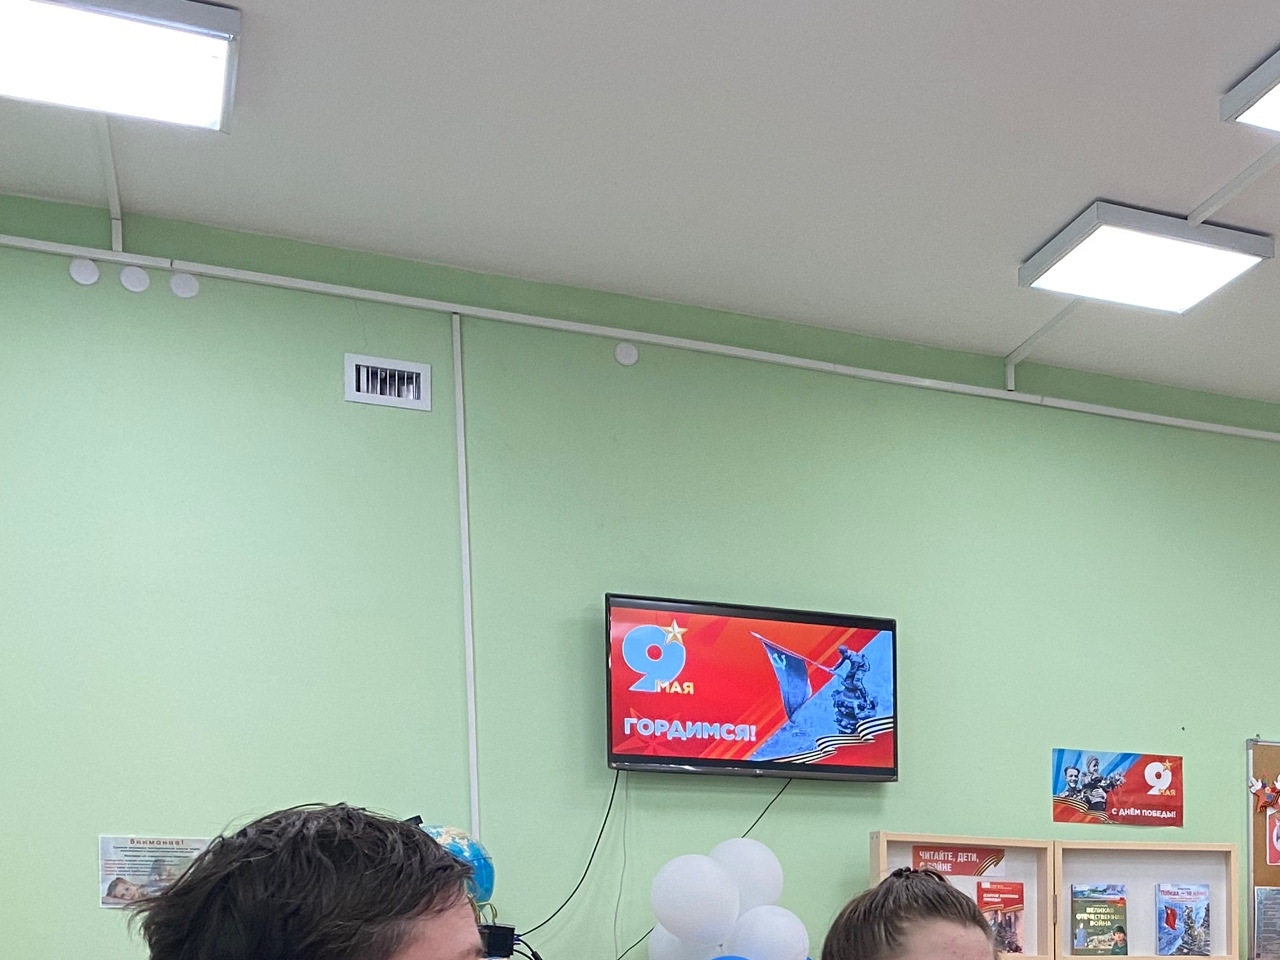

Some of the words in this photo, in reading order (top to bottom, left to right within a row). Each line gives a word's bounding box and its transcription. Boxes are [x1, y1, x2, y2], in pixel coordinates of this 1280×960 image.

[622, 624, 686, 693] 9
[656, 679, 694, 695] МАЯ
[624, 717, 757, 742] ГОРДИМСЯ!
[1144, 761, 1173, 795] 9
[1158, 788, 1176, 796] МАЯ
[1119, 807, 1141, 817] ДНЁМ
[1141, 809, 1177, 819] ПОБЕДЫ!
[130, 838, 184, 846] Внимание!
[919, 850, 956, 861] ЧИТАЙТЕ,
[957, 852, 979, 863] ДЕТИ,
